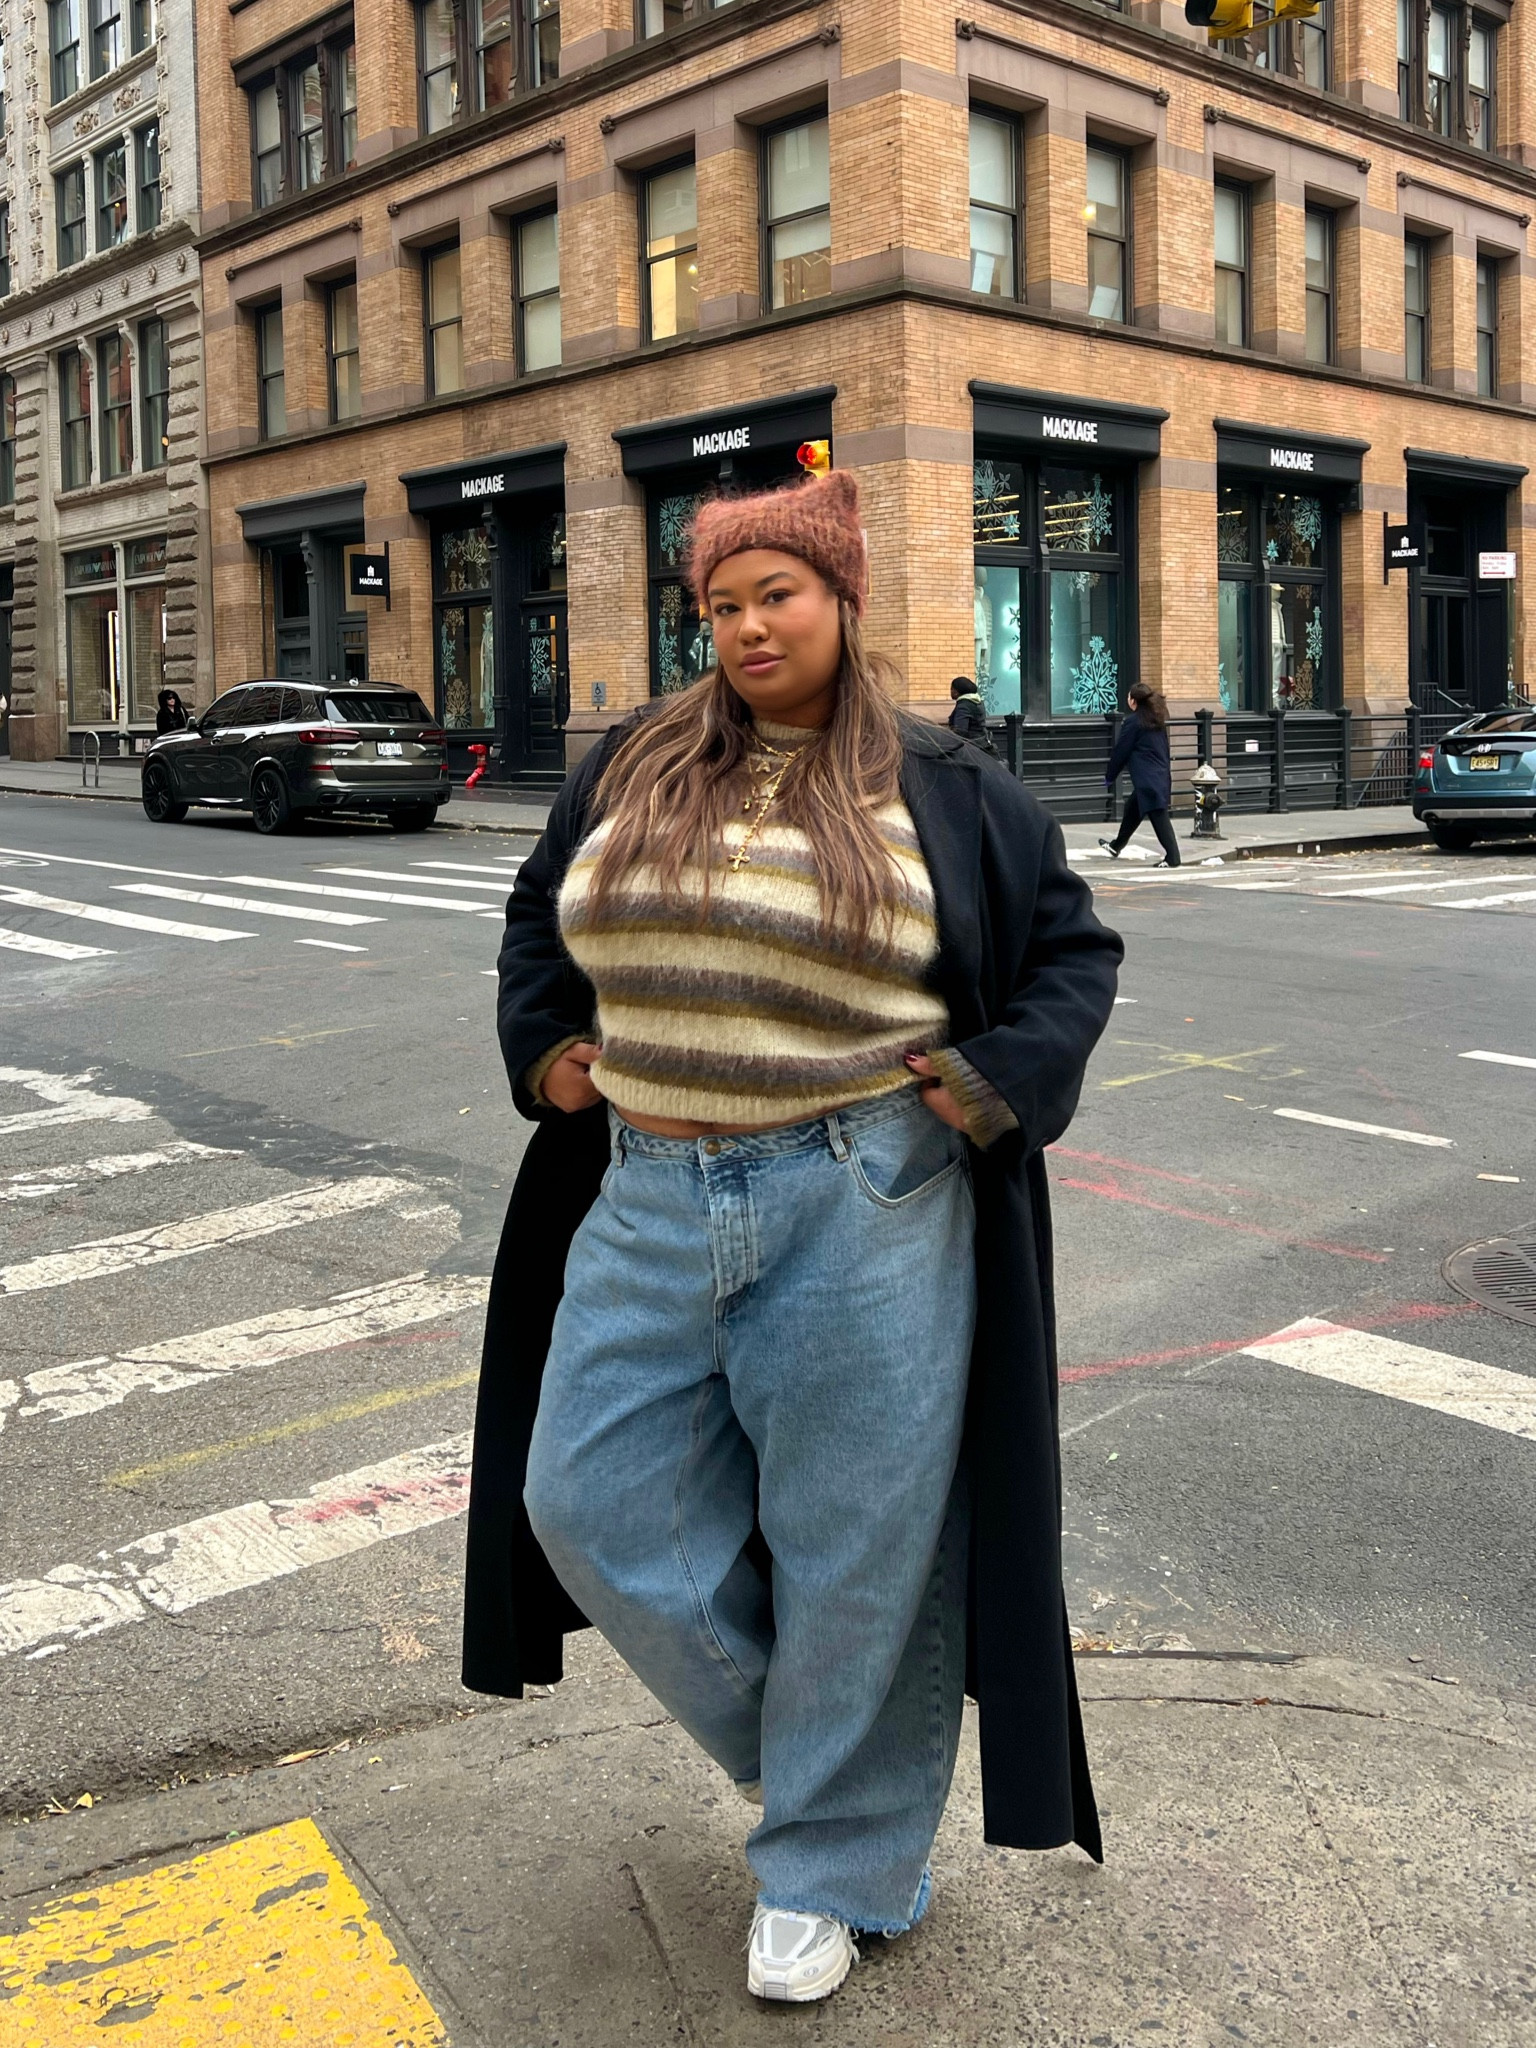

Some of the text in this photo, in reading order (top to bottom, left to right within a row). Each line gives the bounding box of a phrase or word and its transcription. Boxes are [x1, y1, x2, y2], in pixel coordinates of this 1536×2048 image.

[1042, 415, 1098, 443] MACKAGE
[692, 426, 751, 457] MACKAGE
[1270, 448, 1314, 471] MACKAGE
[461, 473, 505, 499] MACKAGE
[1391, 547, 1419, 558] MACKAGE
[359, 577, 384, 586] MACKAGE
